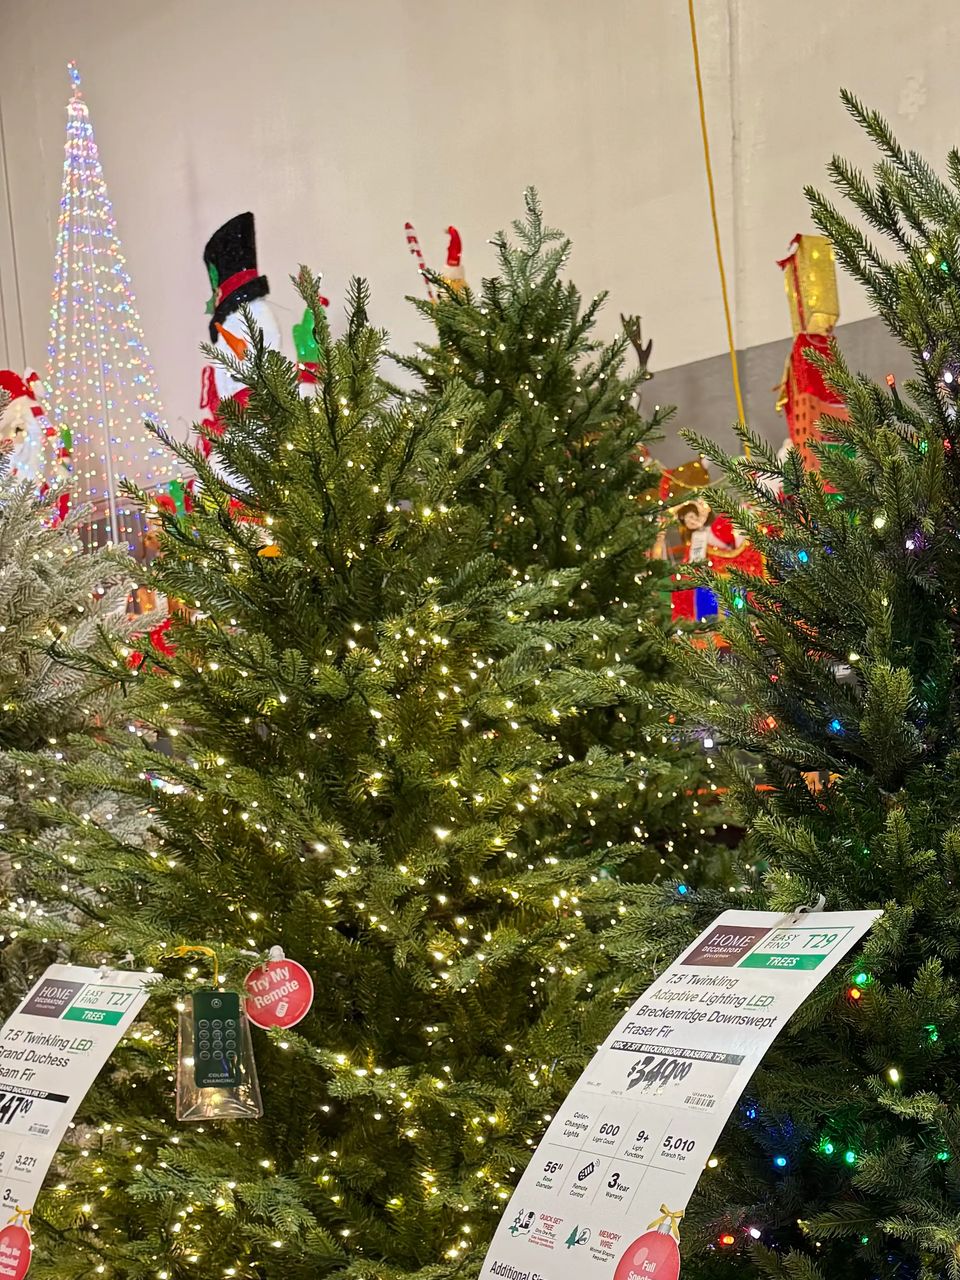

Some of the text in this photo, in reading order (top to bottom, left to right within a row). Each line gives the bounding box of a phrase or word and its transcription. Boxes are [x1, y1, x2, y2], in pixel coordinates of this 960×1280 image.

[708, 934, 756, 947] HOME
[803, 933, 838, 949] T29
[766, 956, 800, 967] TREES
[249, 966, 290, 993] Try My
[687, 974, 740, 989] Twinkling
[39, 986, 73, 1000] HOME
[80, 996, 99, 1004] FIND
[106, 991, 132, 1006] T27
[254, 980, 300, 1008] Remote
[650, 989, 775, 1008] Adaptive Lighting LED
[82, 1010, 106, 1021] TREES
[636, 1005, 778, 1030] Breckenridge Downswept
[622, 1022, 674, 1039] Fraser Fir
[4, 1028, 93, 1052] 7.5' Twinkling LED
[25, 1050, 70, 1068] Duchess
[20, 1068, 36, 1082] Fir
[564, 1119, 589, 1131] Changing
[599, 1123, 620, 1137] 600
[563, 1129, 580, 1139] Lights
[636, 1130, 650, 1143] 9+
[663, 1135, 696, 1152] 5,010
[16, 1155, 37, 1167] 3,271
[599, 1229, 622, 1242] MEMORY
[599, 1239, 614, 1249] WIRE
[642, 1260, 655, 1273] Full
